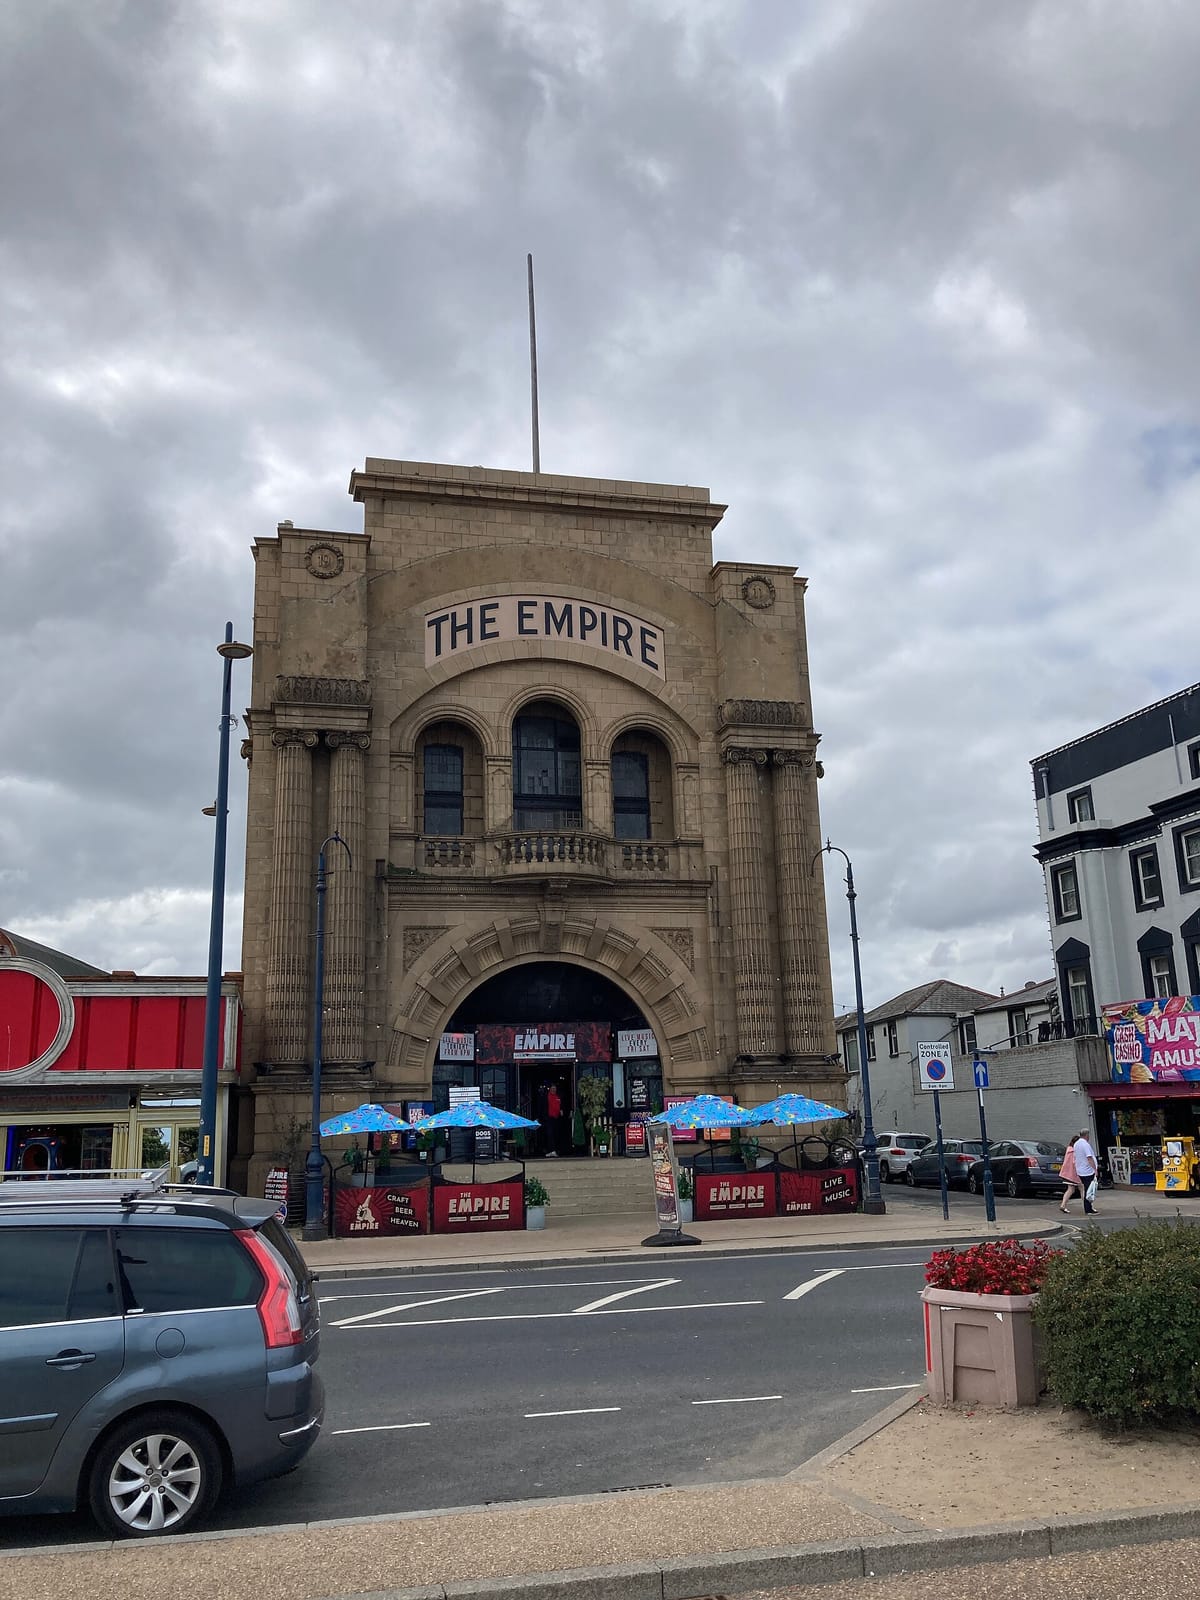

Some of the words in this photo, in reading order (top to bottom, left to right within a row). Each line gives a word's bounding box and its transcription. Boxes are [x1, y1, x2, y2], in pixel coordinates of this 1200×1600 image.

[427, 602, 500, 657] THE
[517, 600, 659, 671] EMPIRE
[621, 1034, 634, 1042] LIVE
[636, 1033, 655, 1041] MUSIC
[1115, 1026, 1134, 1043] CASH
[514, 1034, 576, 1050] EMPIRE
[1115, 1042, 1141, 1060] CASINO
[824, 1176, 843, 1189] LIVE
[387, 1194, 409, 1204] CRAFT
[710, 1186, 765, 1201] EMPIRE
[825, 1189, 851, 1204] MUSIC
[395, 1206, 413, 1216] BEER
[448, 1196, 510, 1213] EMPIRE
[786, 1203, 812, 1211] EMPIRE
[349, 1222, 380, 1231] EMPIRE
[390, 1217, 419, 1228] HEAVEN
